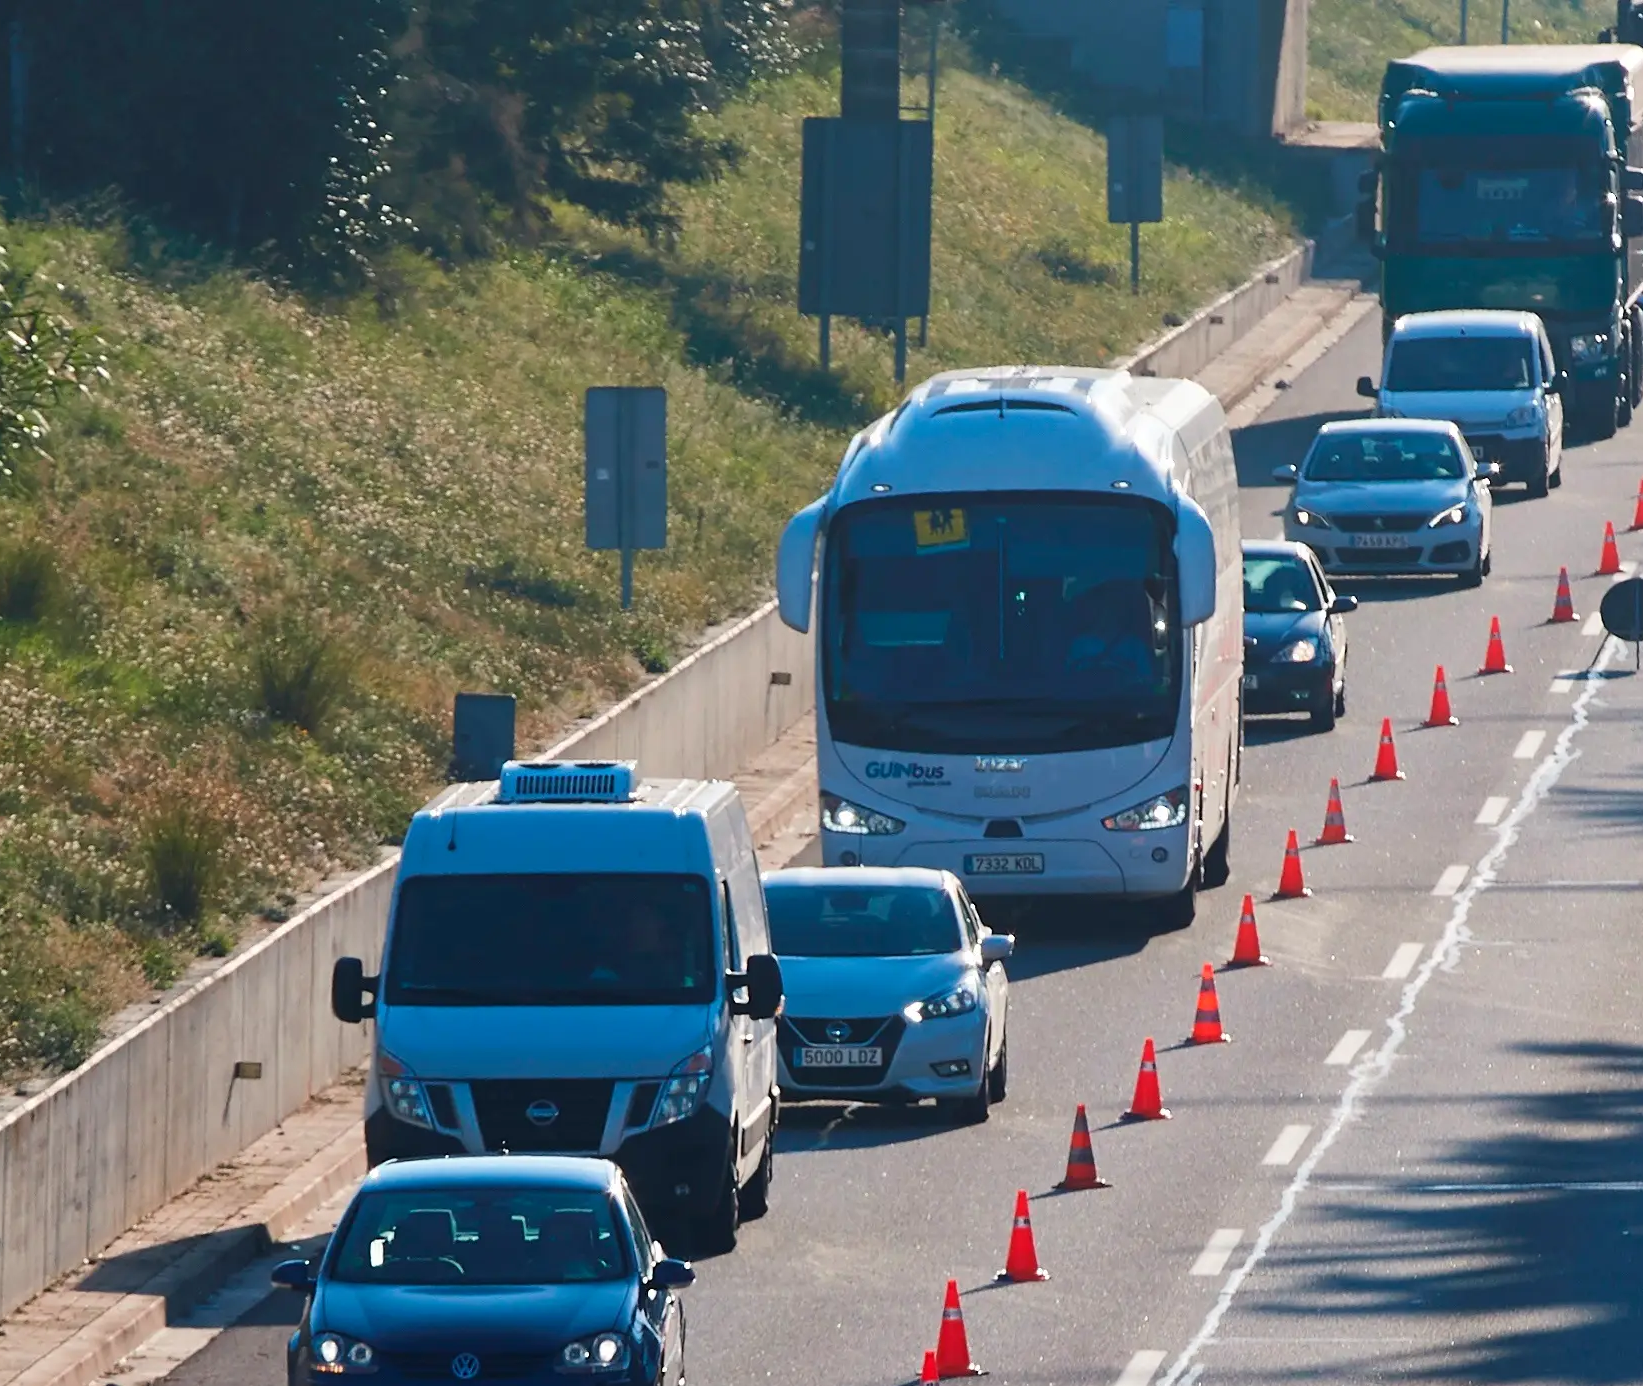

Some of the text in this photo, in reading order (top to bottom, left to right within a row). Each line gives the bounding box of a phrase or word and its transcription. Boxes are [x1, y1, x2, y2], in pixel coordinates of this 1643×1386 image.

[865, 761, 945, 779] GUINbus
[975, 858, 1039, 871] 7332 KDL
[804, 1050, 878, 1064] 5000 LDZ
